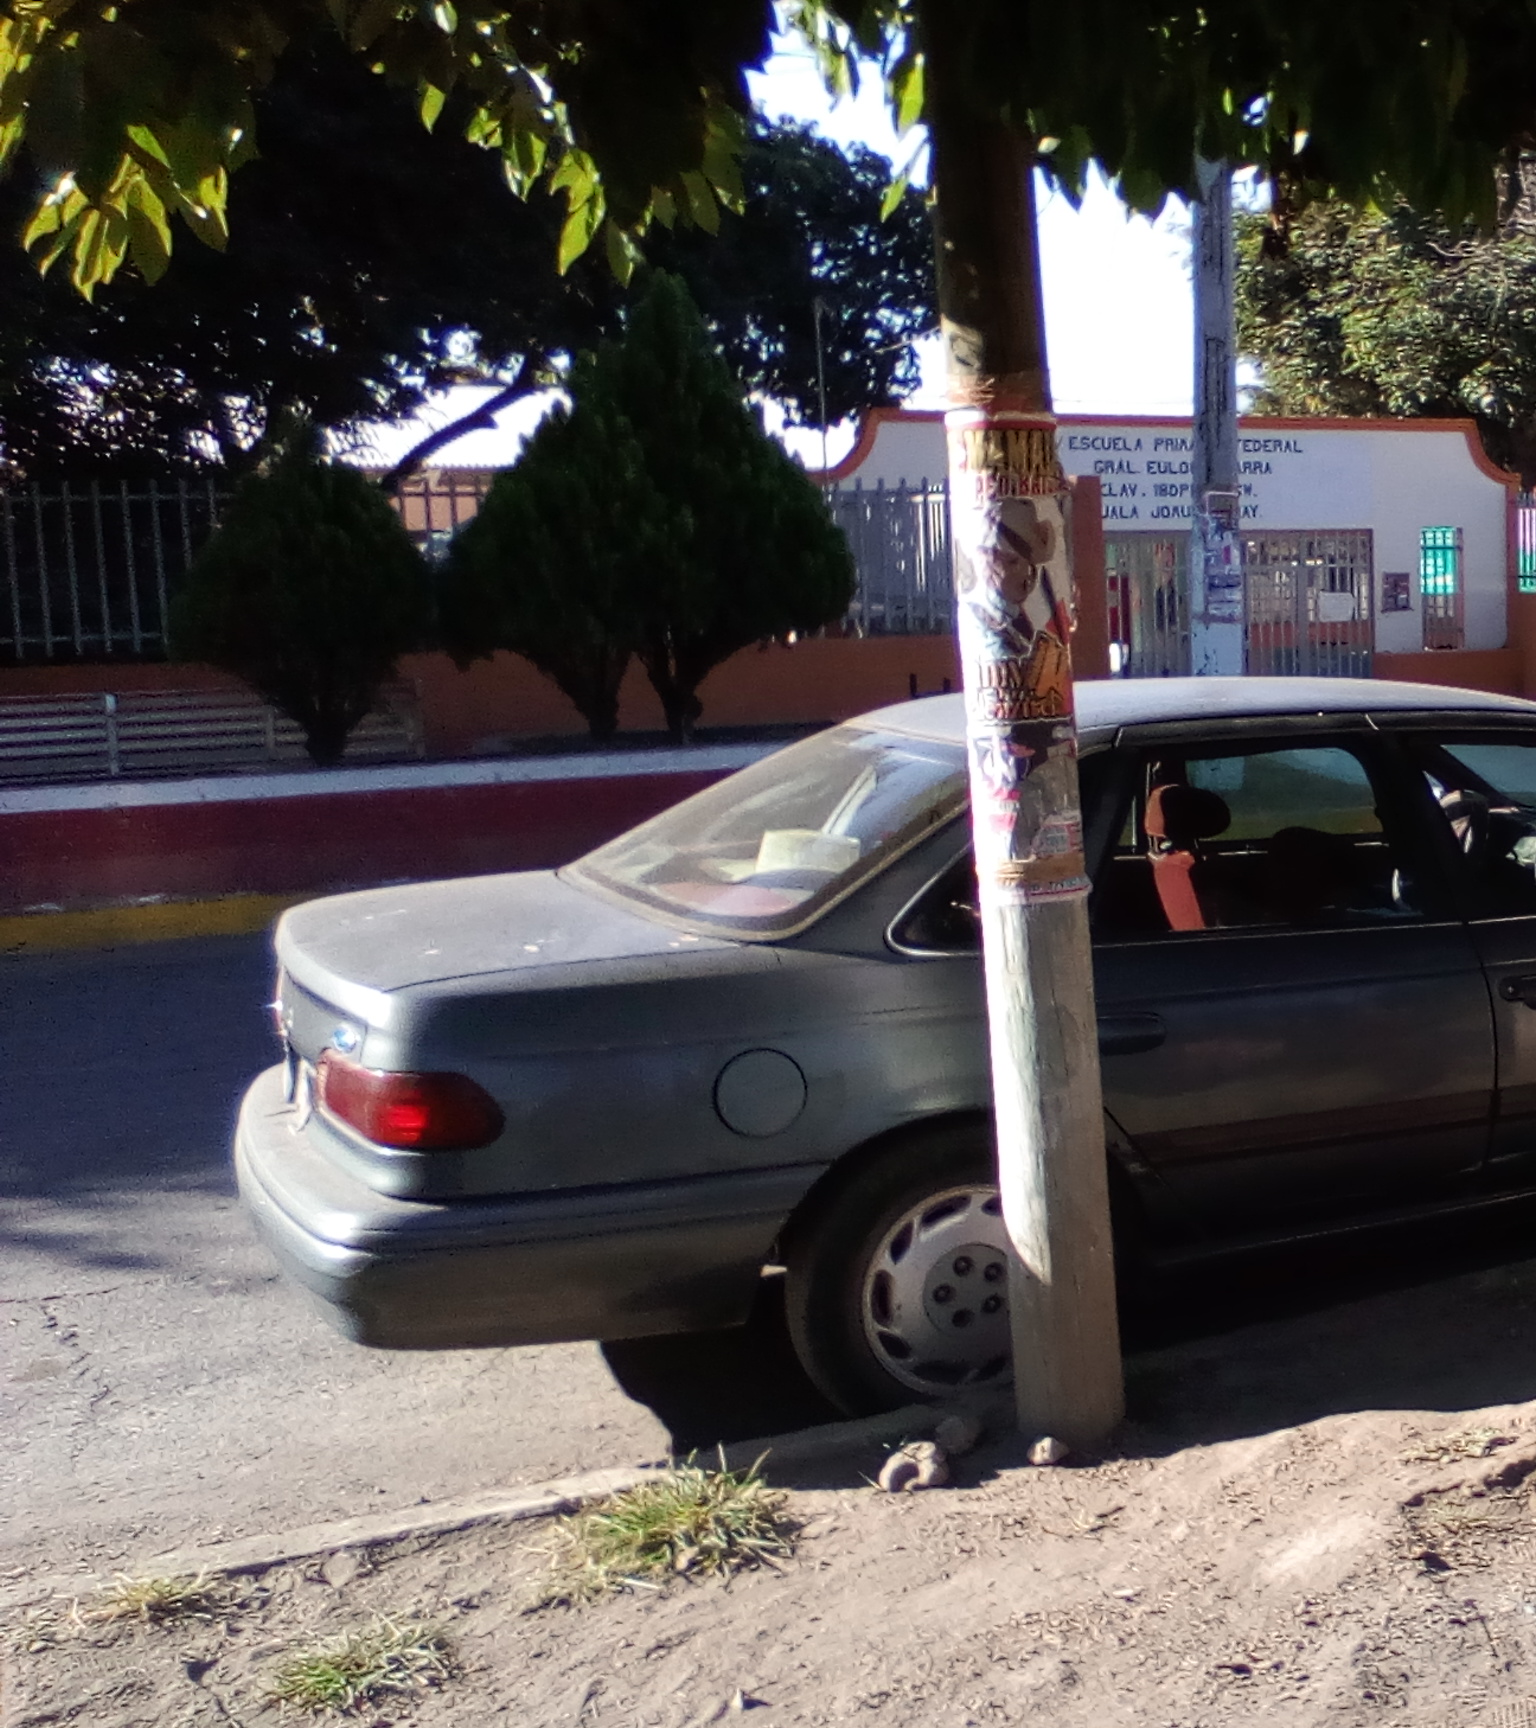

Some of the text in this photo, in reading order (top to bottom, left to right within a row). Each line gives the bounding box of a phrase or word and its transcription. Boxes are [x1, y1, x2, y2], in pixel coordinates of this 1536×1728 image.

[1068, 436, 1142, 451] ESCUELA
[1146, 461, 1190, 475] EULO
[1153, 483, 1190, 498] 18DP
[1151, 504, 1192, 519] JOMU
